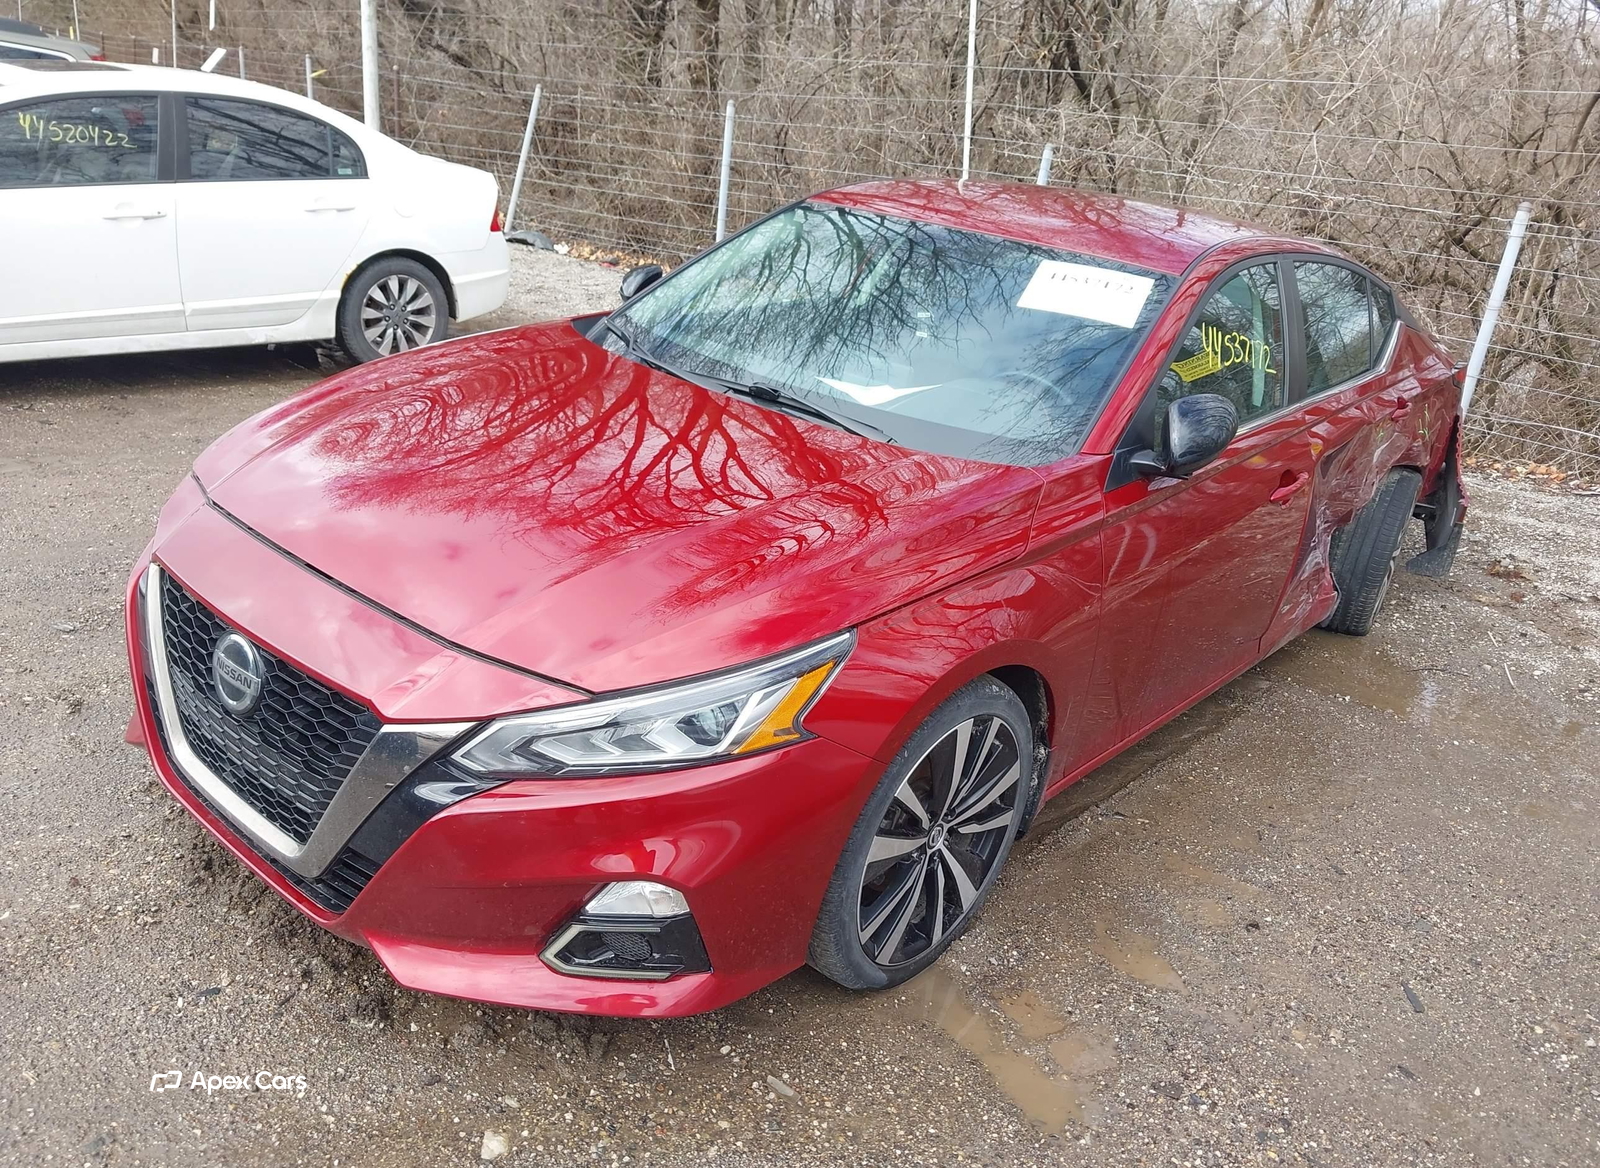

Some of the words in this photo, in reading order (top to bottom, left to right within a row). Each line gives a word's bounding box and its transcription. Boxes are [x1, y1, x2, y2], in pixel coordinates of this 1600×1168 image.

[18, 111, 138, 148] 44520422
[1201, 321, 1277, 375] 44537172
[216, 656, 252, 690] NISSAN
